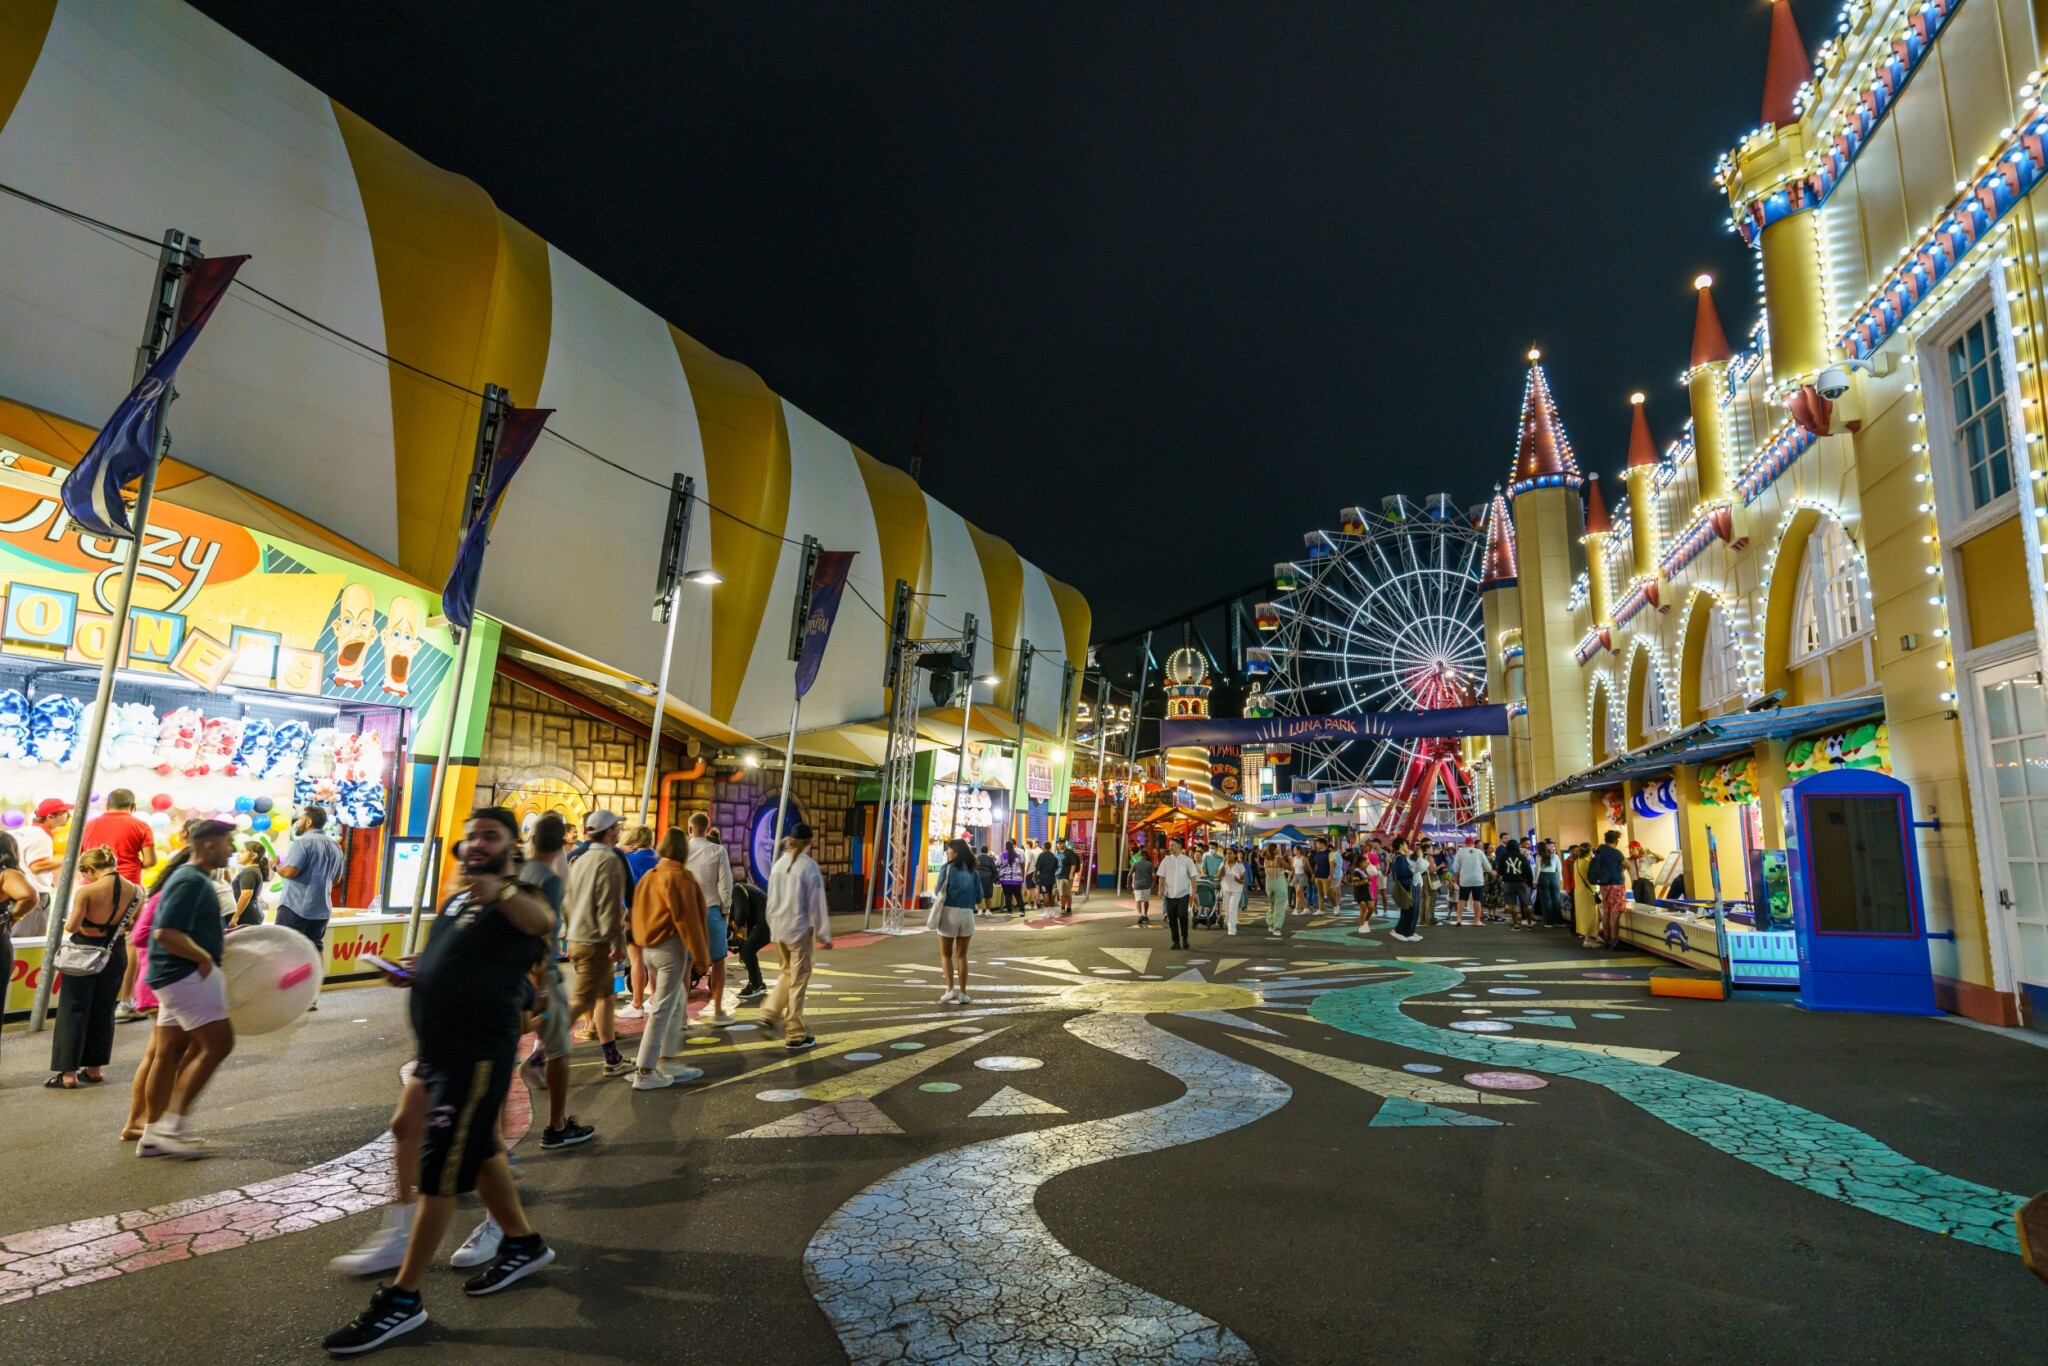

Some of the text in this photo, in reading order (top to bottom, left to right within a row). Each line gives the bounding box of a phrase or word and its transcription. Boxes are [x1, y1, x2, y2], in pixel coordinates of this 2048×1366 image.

[1288, 719, 1358, 736] LUNA PARK
[1505, 856, 1522, 875] NY
[333, 933, 390, 961] win!
